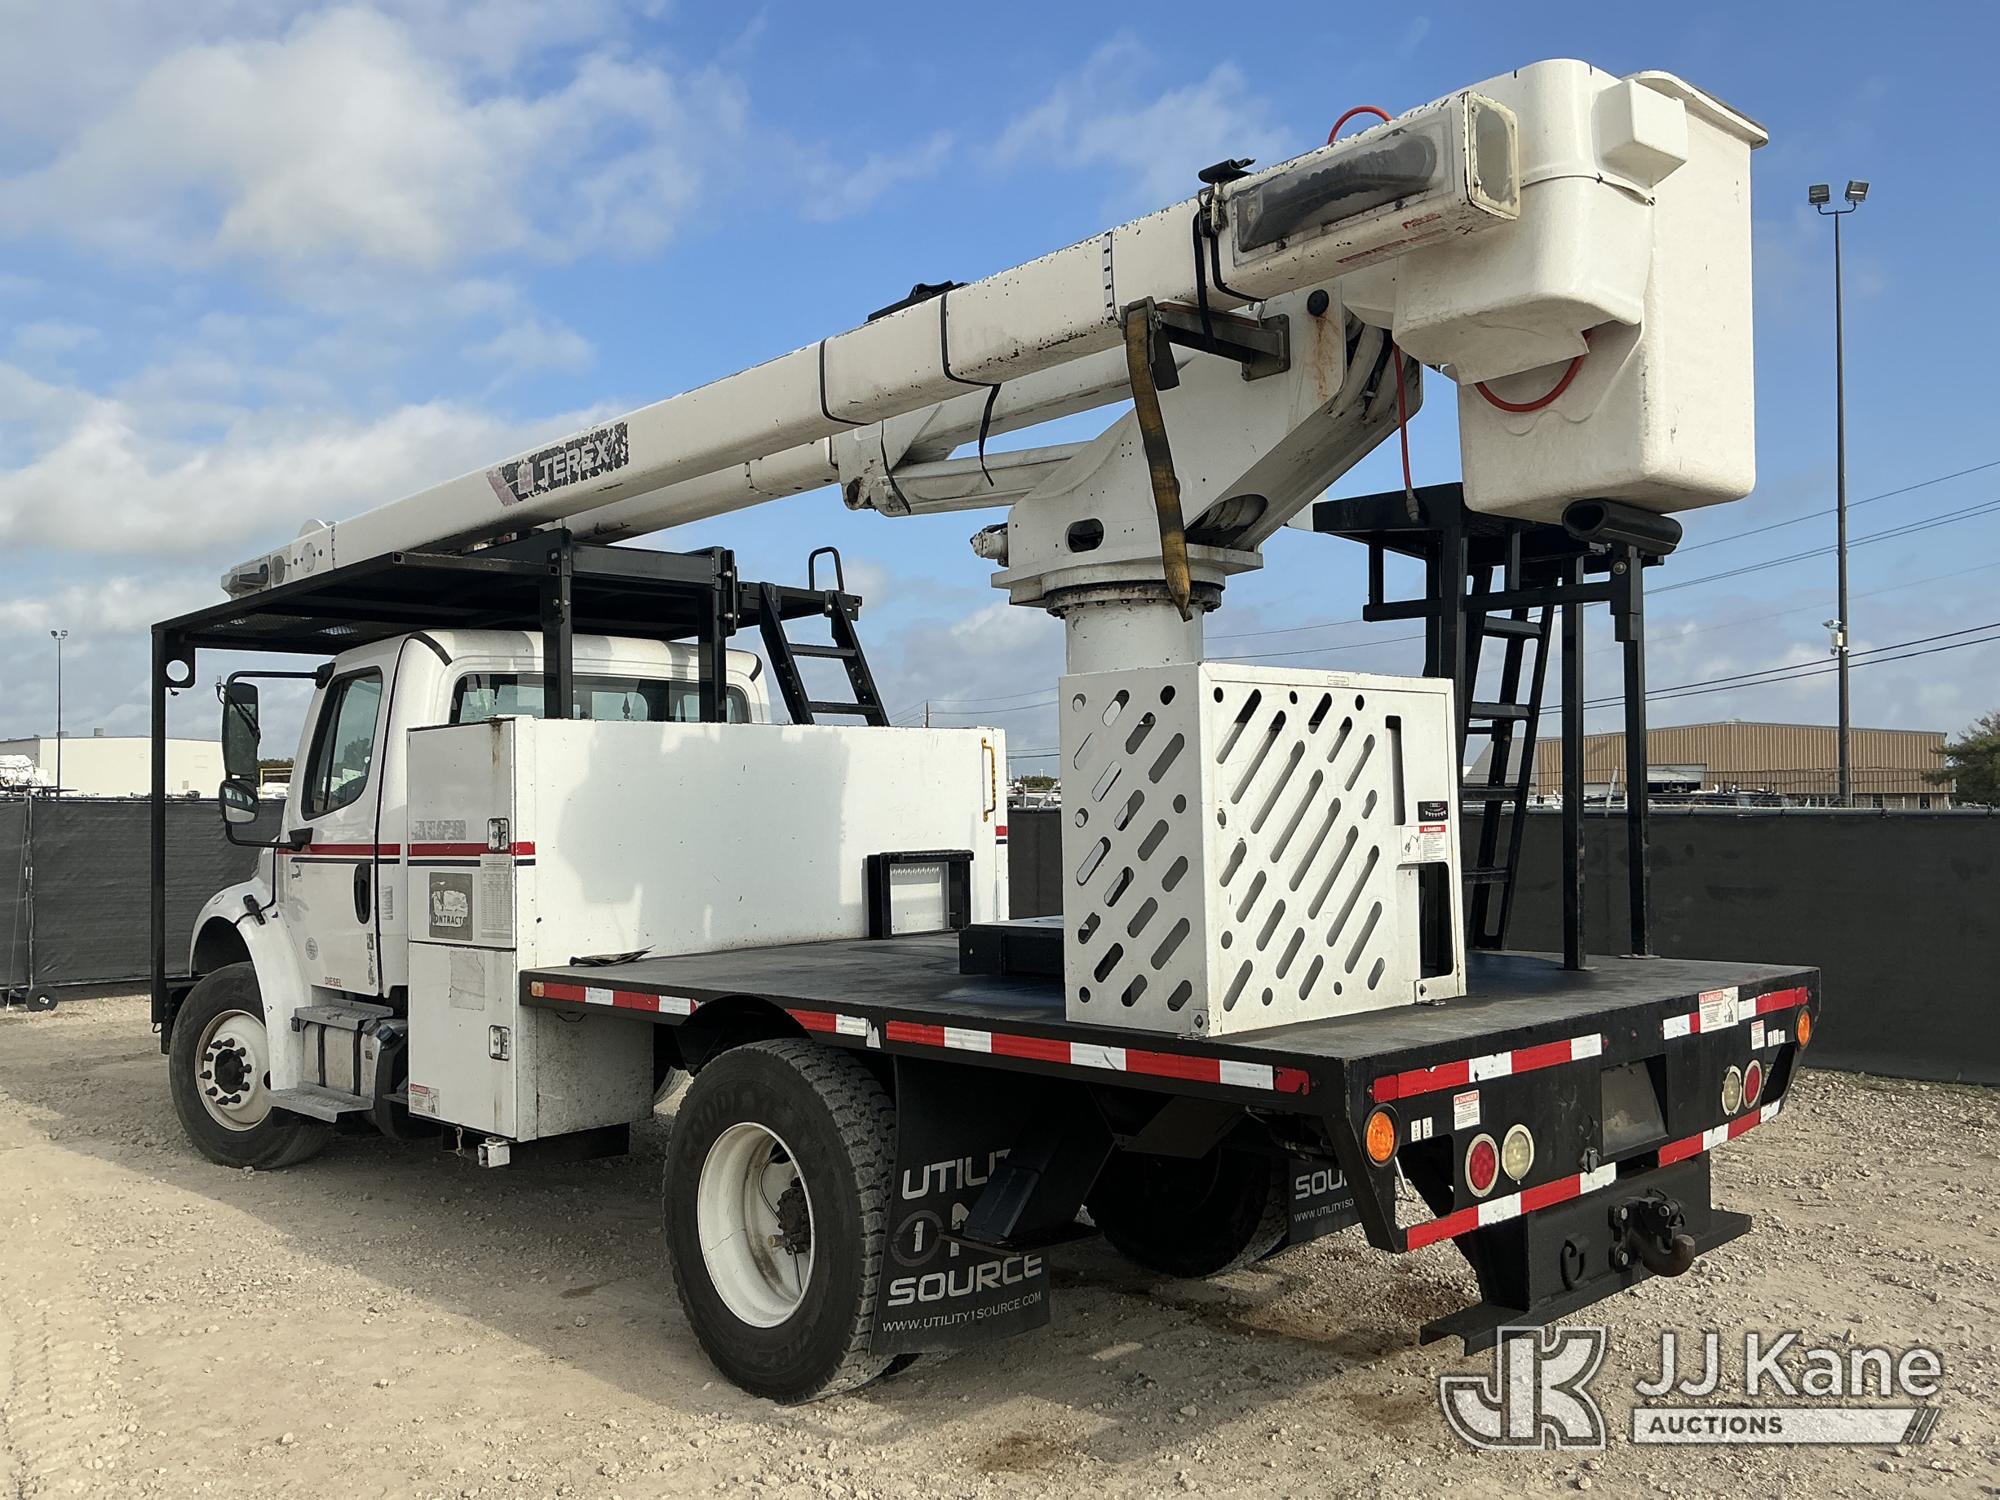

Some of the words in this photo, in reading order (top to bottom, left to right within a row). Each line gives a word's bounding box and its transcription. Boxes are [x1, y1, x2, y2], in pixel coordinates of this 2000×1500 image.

[540, 439, 612, 486] TEREX
[1295, 1169, 1348, 1200] SOU
[887, 1254, 1043, 1307] SOURCE
[882, 1291, 1042, 1332] WWW.UTILITY1SOURCE.COM
